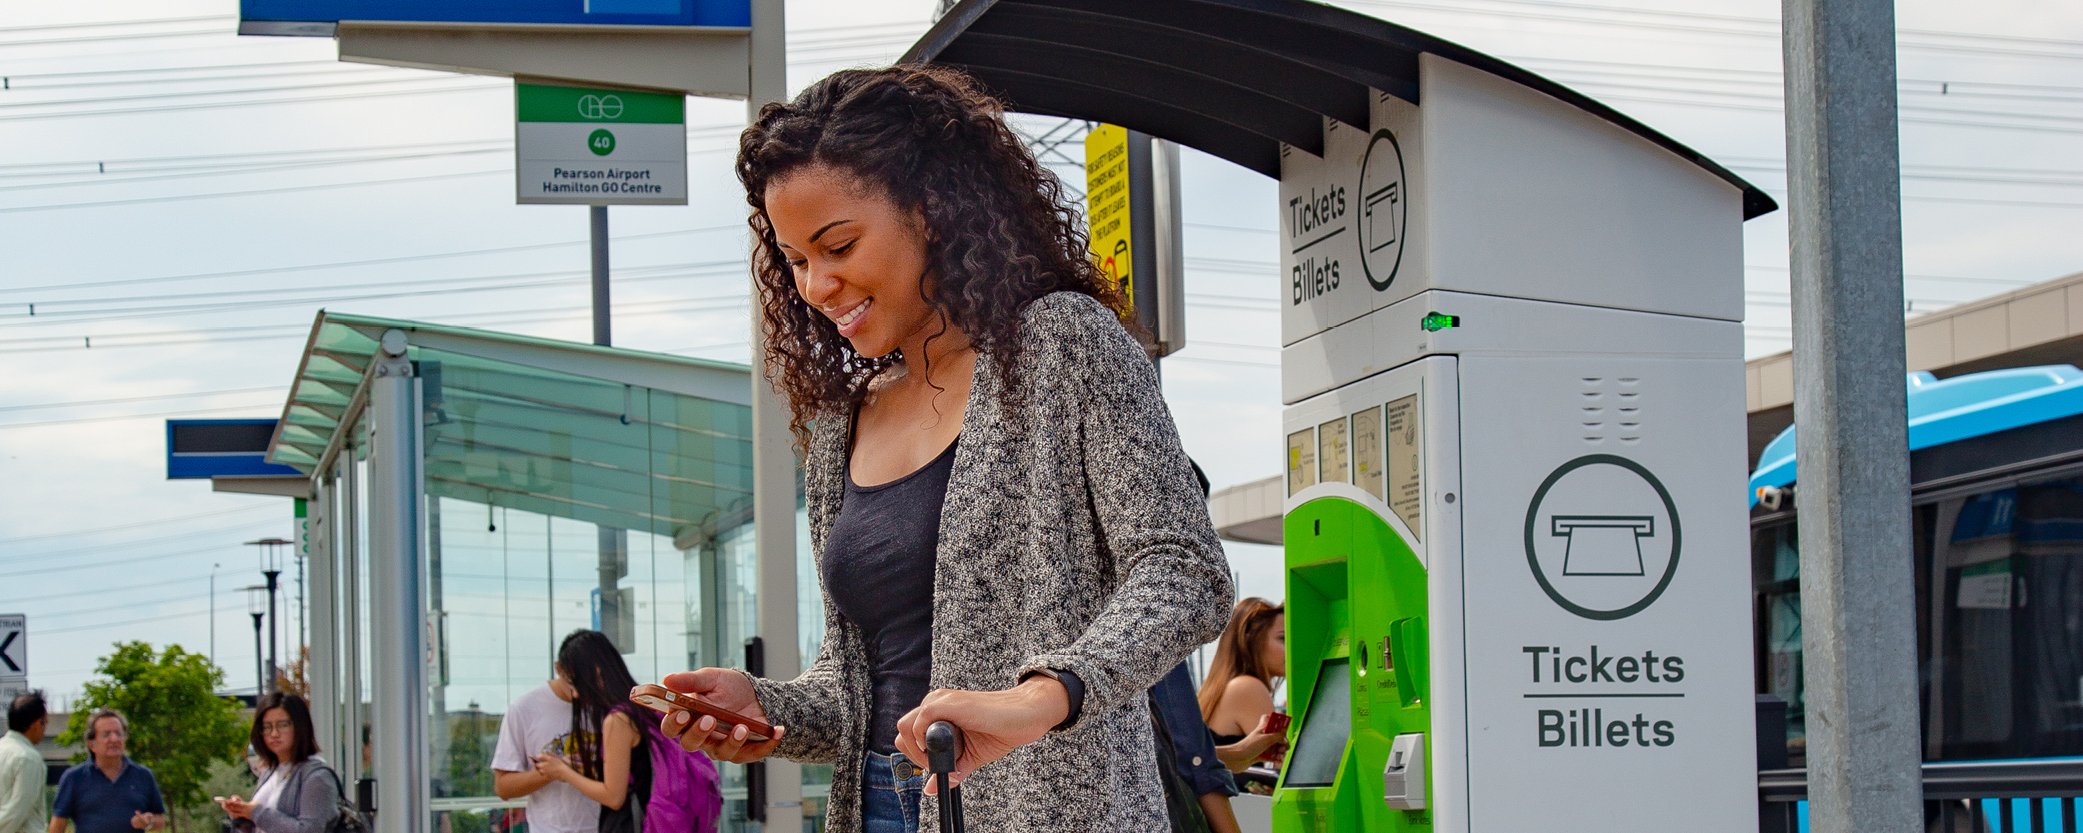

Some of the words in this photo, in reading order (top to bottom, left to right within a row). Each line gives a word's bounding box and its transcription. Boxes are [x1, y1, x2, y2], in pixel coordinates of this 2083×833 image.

[594, 137, 610, 148] 40
[543, 182, 599, 193] Hamilton
[601, 182, 618, 193] GO
[621, 182, 662, 194] Centre
[554, 168, 604, 179] Pearson
[606, 168, 651, 180] Airport
[1290, 184, 1346, 238] Tickets
[1293, 256, 1340, 306] Billets
[1522, 645, 1685, 683] Tickets
[1538, 708, 1675, 747] Billets
